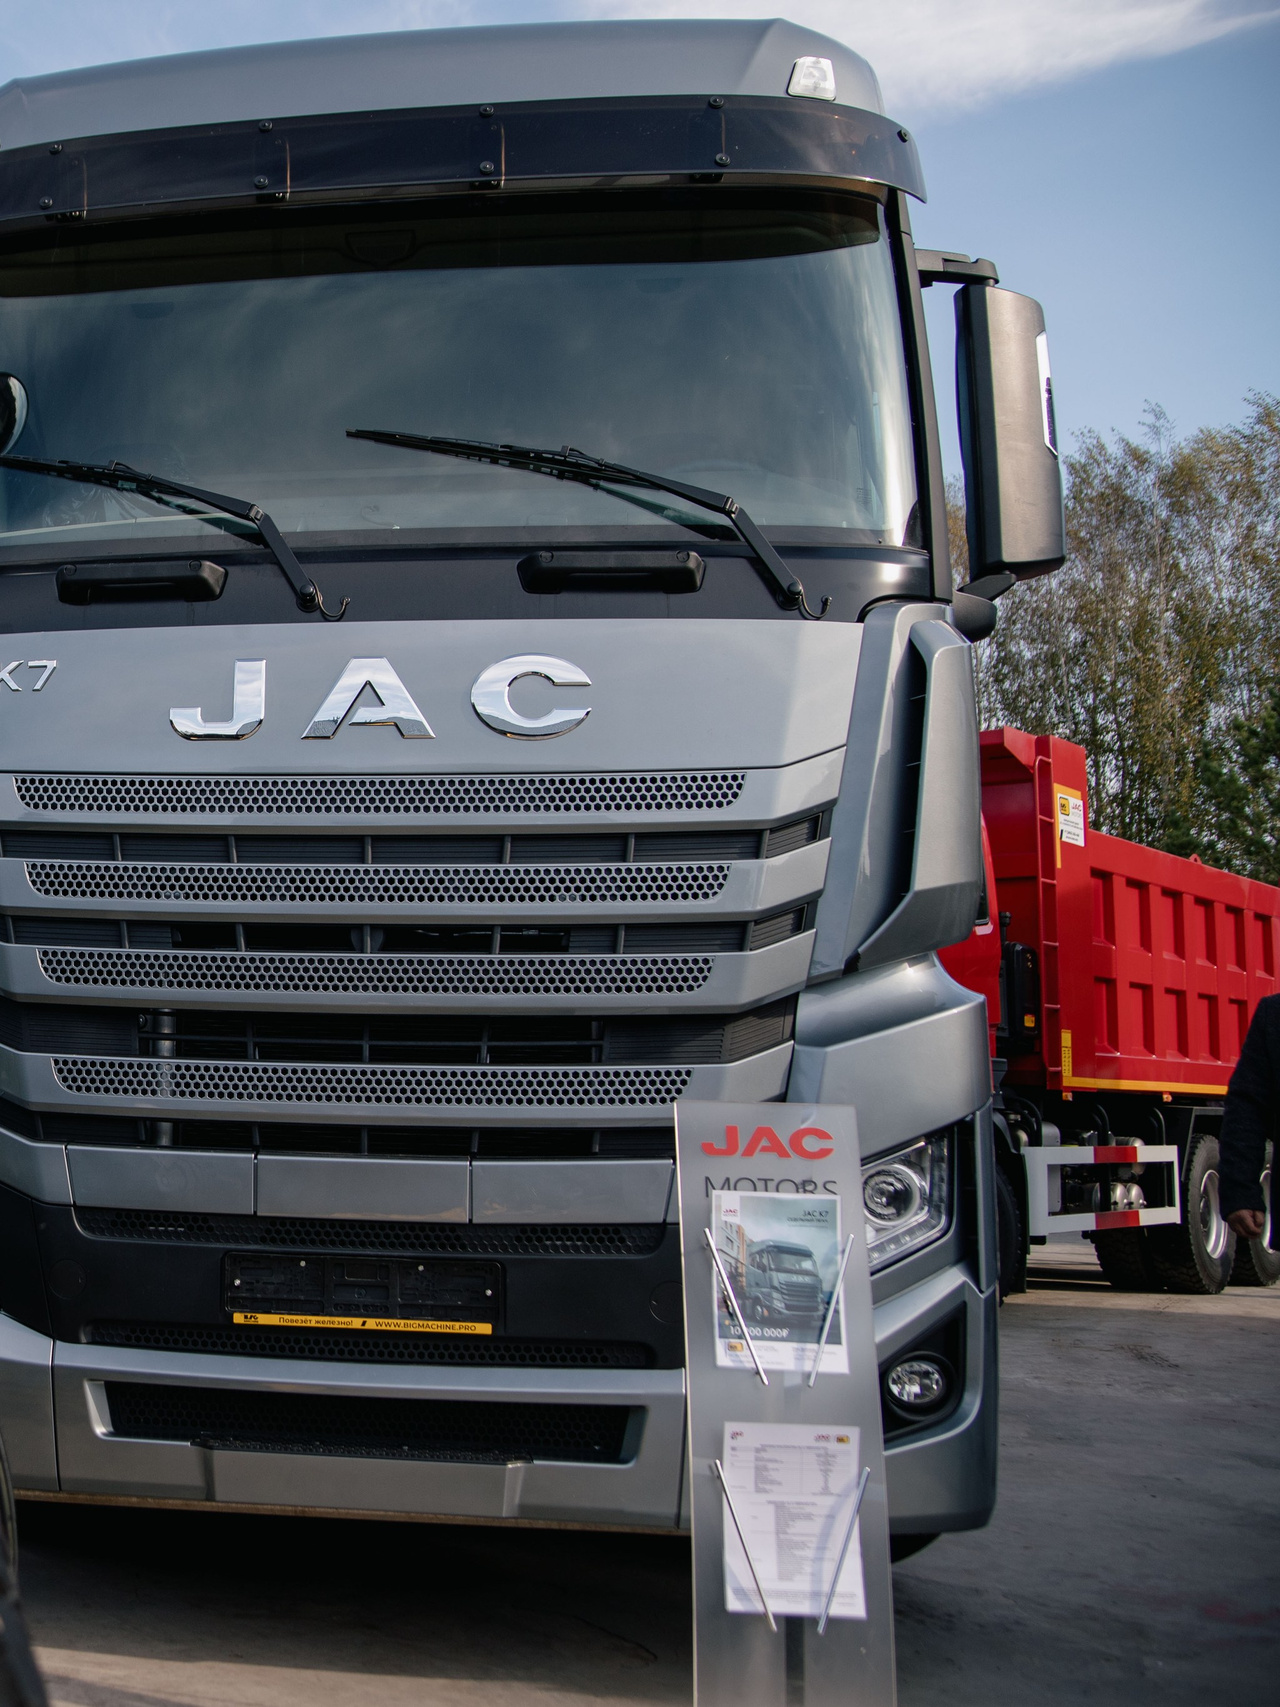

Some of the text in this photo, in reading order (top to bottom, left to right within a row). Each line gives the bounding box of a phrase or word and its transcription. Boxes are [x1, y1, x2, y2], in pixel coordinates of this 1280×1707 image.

[169, 652, 593, 742] JAC
[701, 1125, 835, 1160] JAC
[704, 1176, 838, 1198] MOTORS
[802, 1210, 818, 1218] JAC
[374, 1320, 477, 1332] WWW.BIGMACHINE.PRO
